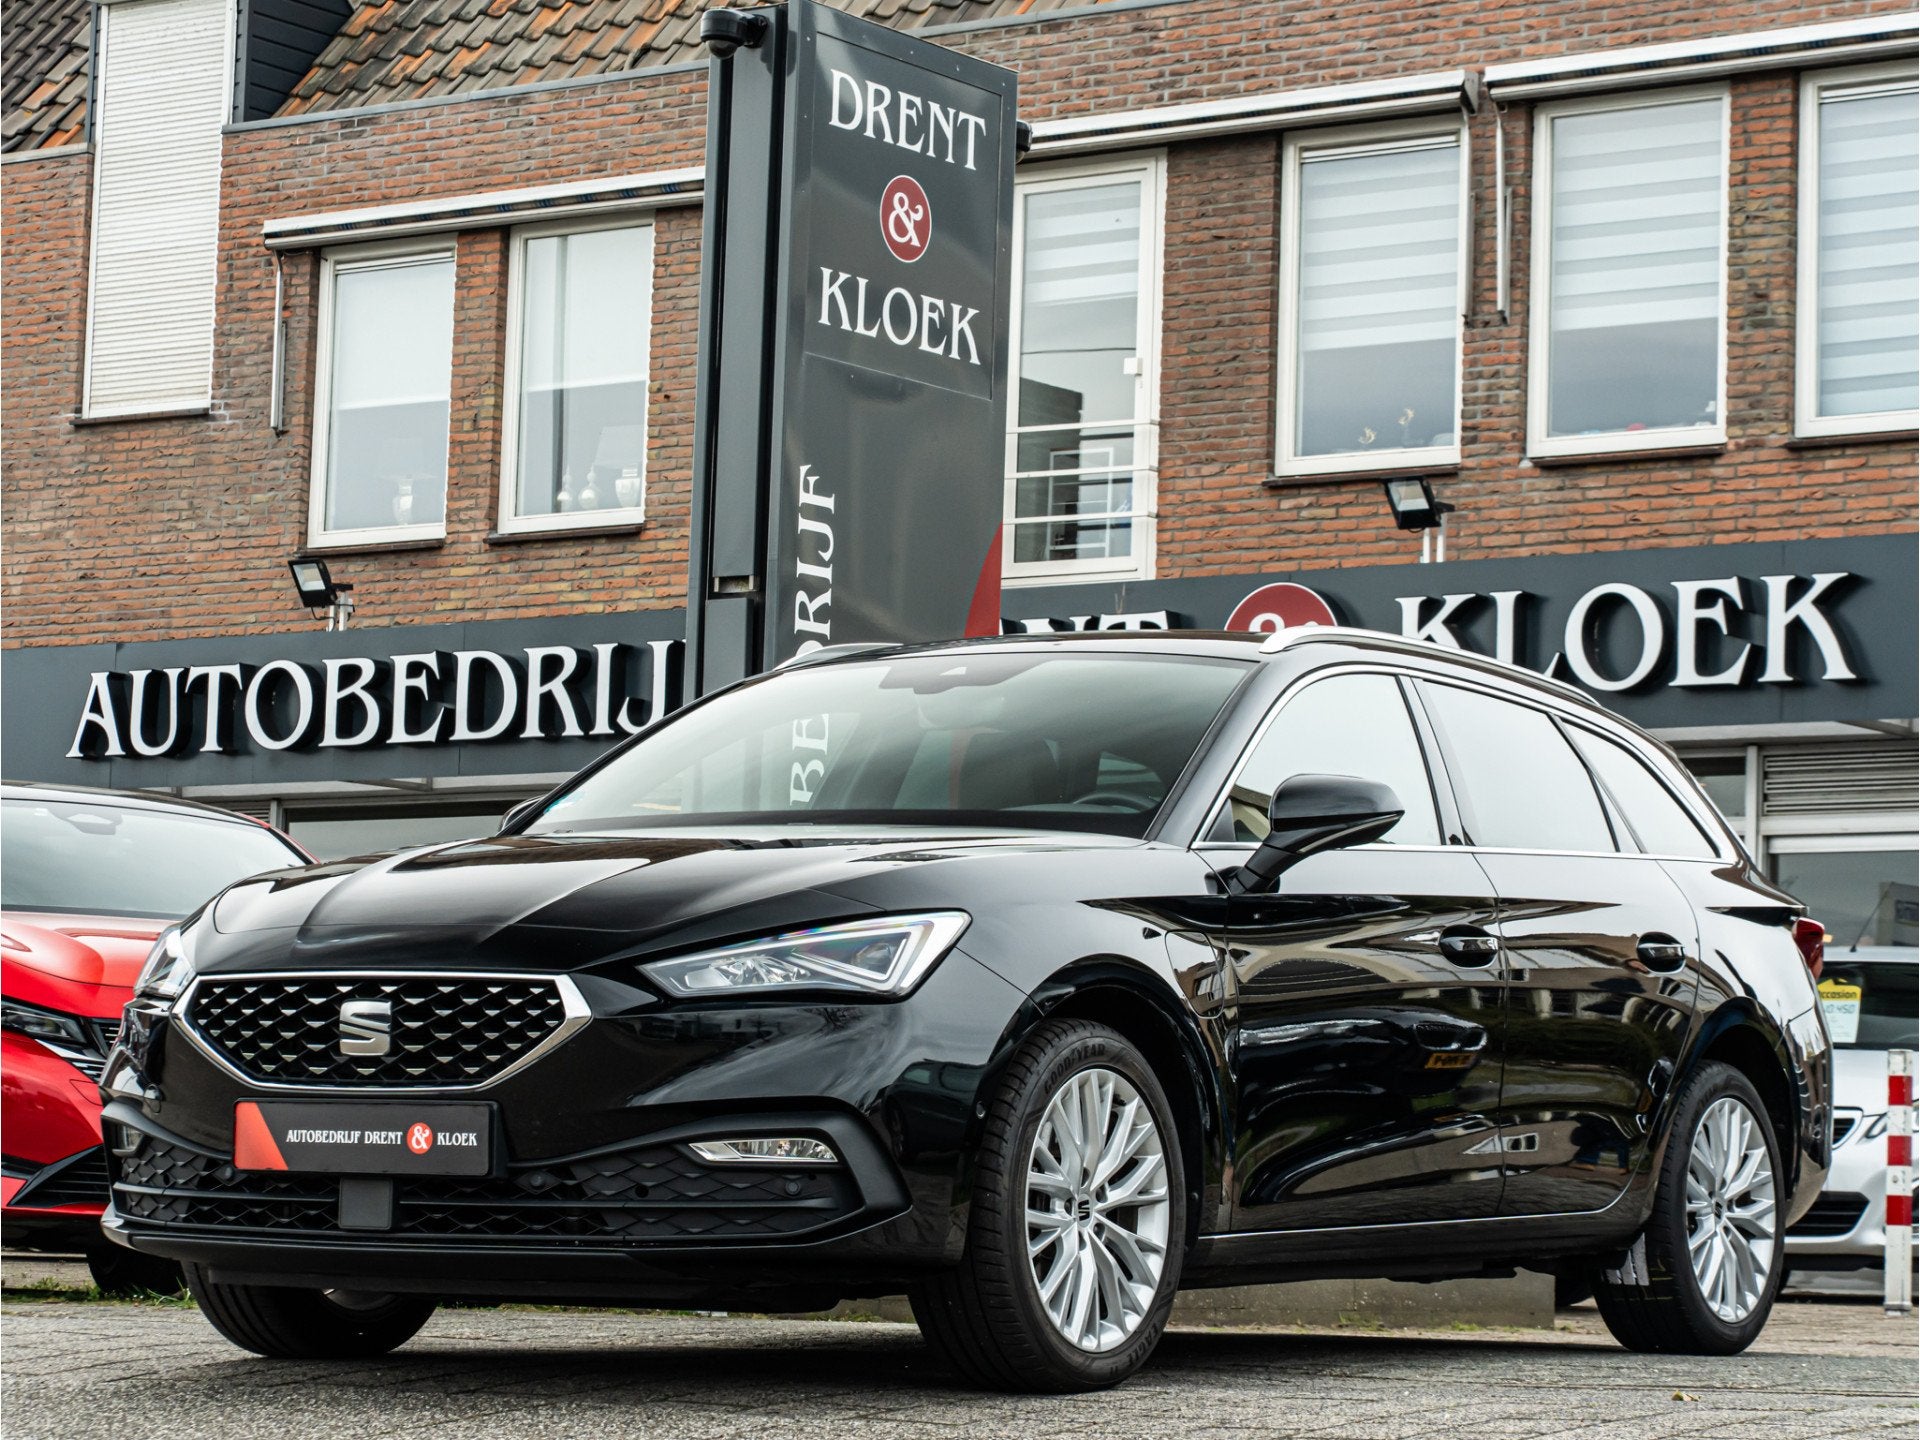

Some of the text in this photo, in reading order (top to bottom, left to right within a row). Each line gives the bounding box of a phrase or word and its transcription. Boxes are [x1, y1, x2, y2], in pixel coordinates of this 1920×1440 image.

[829, 68, 986, 171] DRENT
[888, 192, 923, 247] &
[818, 266, 981, 365] KLOEK
[66, 639, 686, 758] AUTOBEDRIJ
[286, 1125, 478, 1150] AUTOBEDRIJF DRENT & KLOEK
